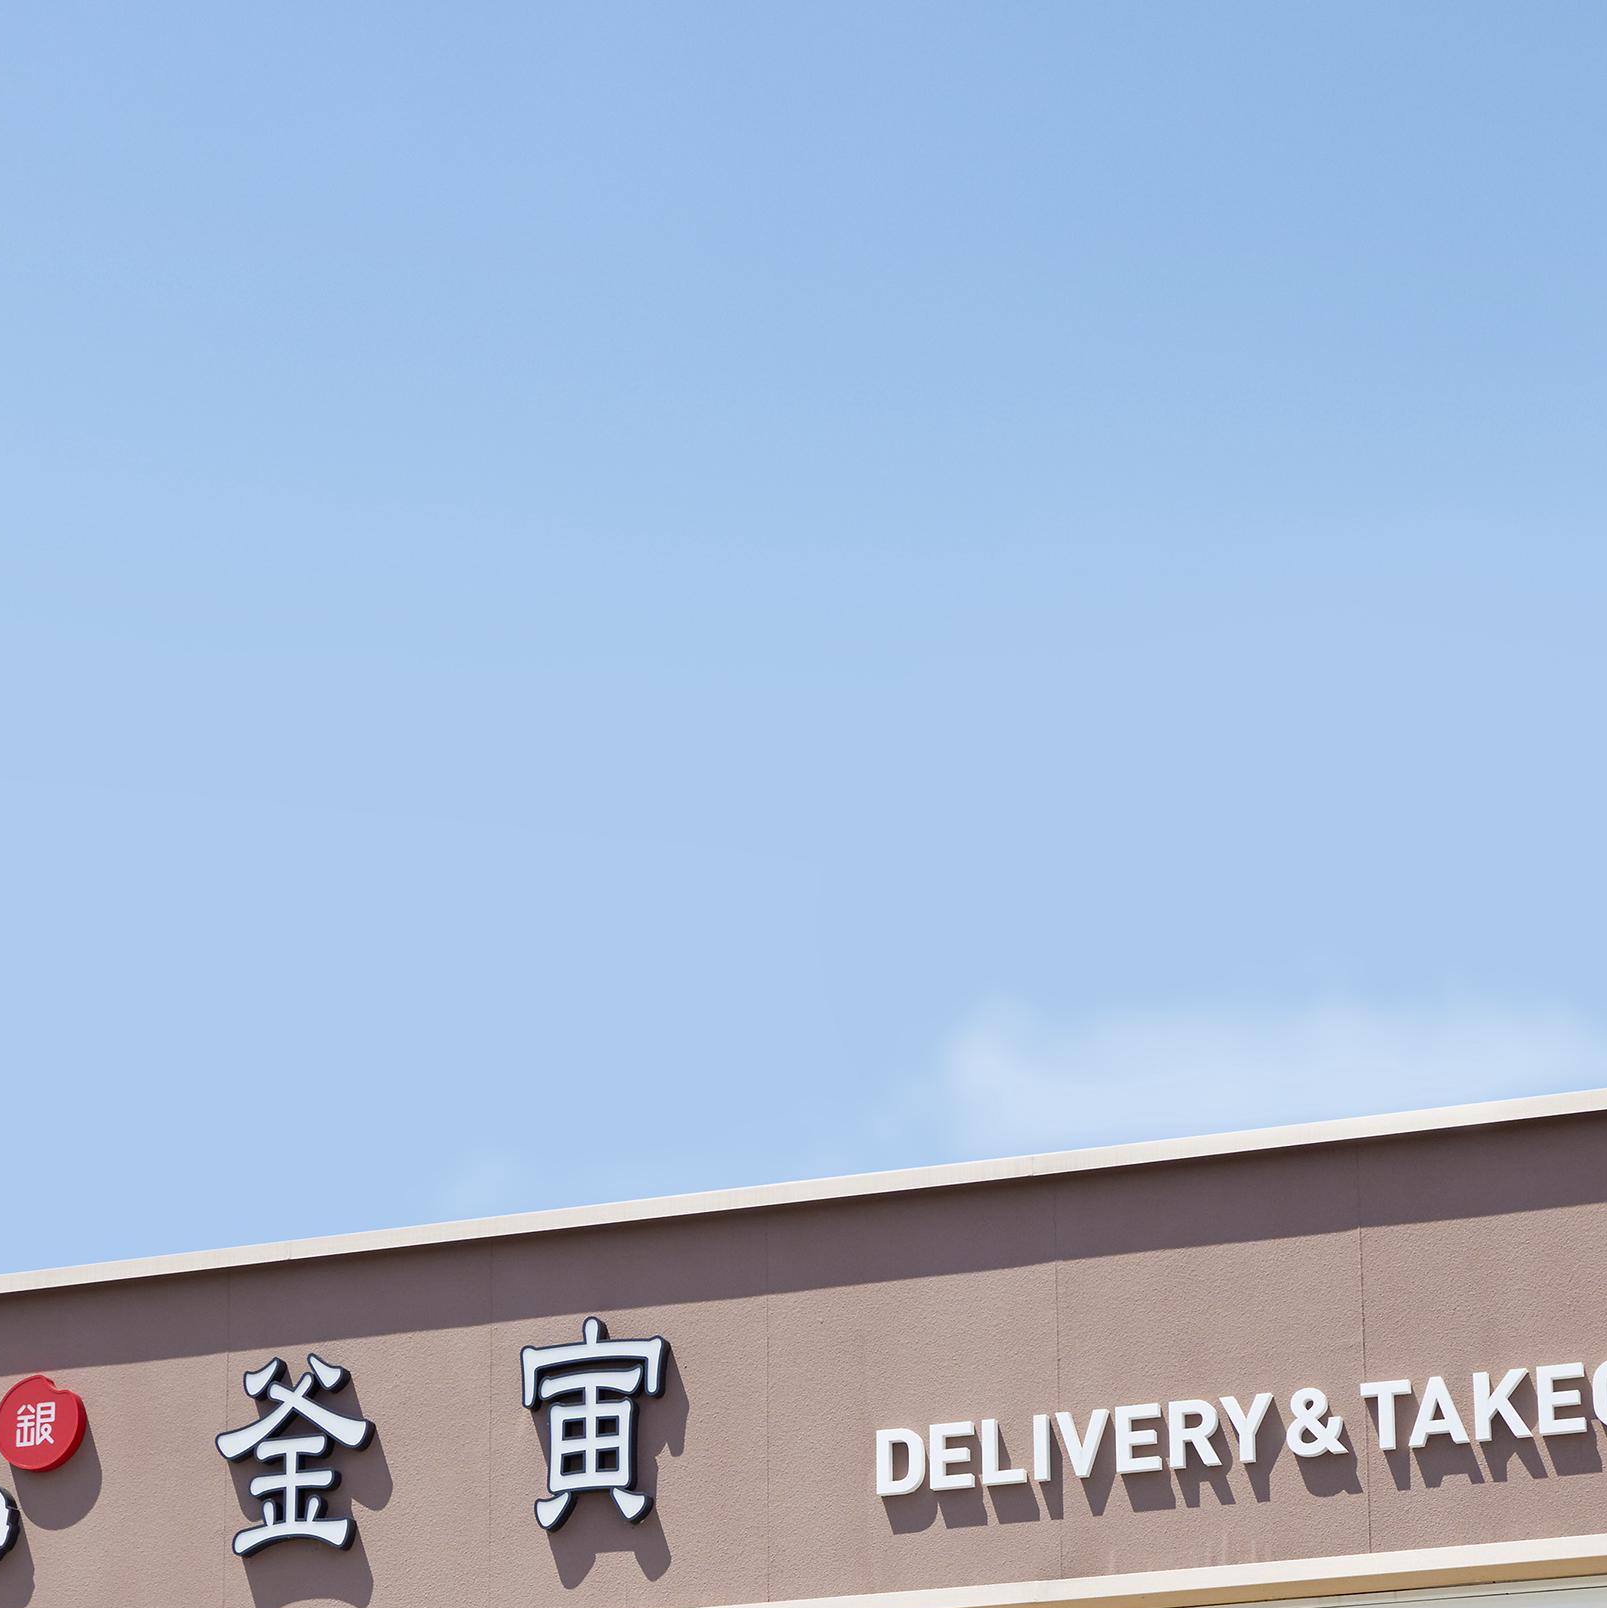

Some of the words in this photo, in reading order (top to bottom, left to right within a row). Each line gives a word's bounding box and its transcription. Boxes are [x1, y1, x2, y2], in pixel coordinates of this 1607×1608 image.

[15, 1401, 55, 1448] 銀
[215, 1317, 671, 1557] 釜寅
[876, 1393, 1273, 1497] DELIVERY
[1285, 1387, 1348, 1457] &
